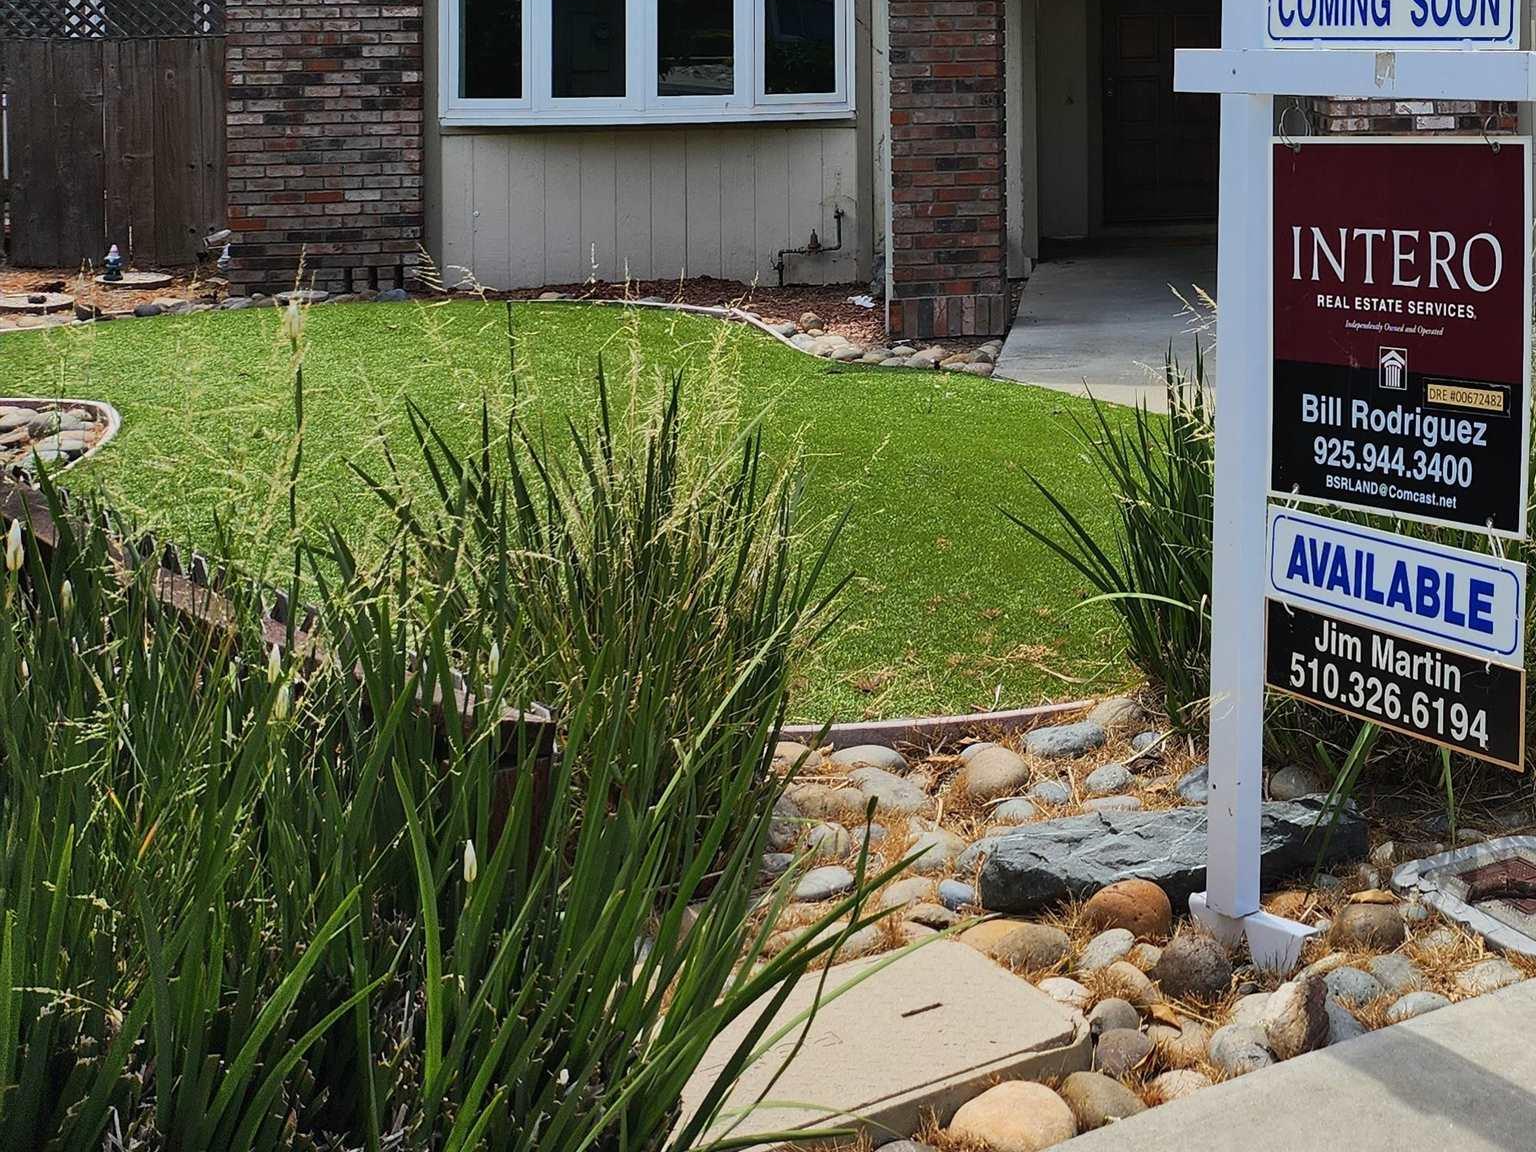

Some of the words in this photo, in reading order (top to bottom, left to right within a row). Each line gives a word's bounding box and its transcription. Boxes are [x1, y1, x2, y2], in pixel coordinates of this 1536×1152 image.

[1291, 226, 1503, 292] INTERO
[1317, 294, 1350, 309] REAL
[1354, 296, 1403, 313] ESTATE
[1345, 319, 1383, 332] Independently
[1384, 322, 1404, 332] Owned
[1405, 325, 1416, 334] and
[1417, 325, 1444, 336] Operated
[1302, 393, 1342, 426] Bill
[1351, 399, 1488, 447] Rodriguez
[1429, 388, 1448, 402] DRE
[1450, 390, 1503, 408] #00672482
[1313, 436, 1473, 488] 925.944.3400
[1326, 474, 1457, 509] BSRLAND@Comcast.net
[1286, 534, 1495, 635] AVAILABLE
[1314, 619, 1362, 663] Jim
[1371, 635, 1461, 693] Martin
[1290, 652, 1489, 748] 510.326.6194
